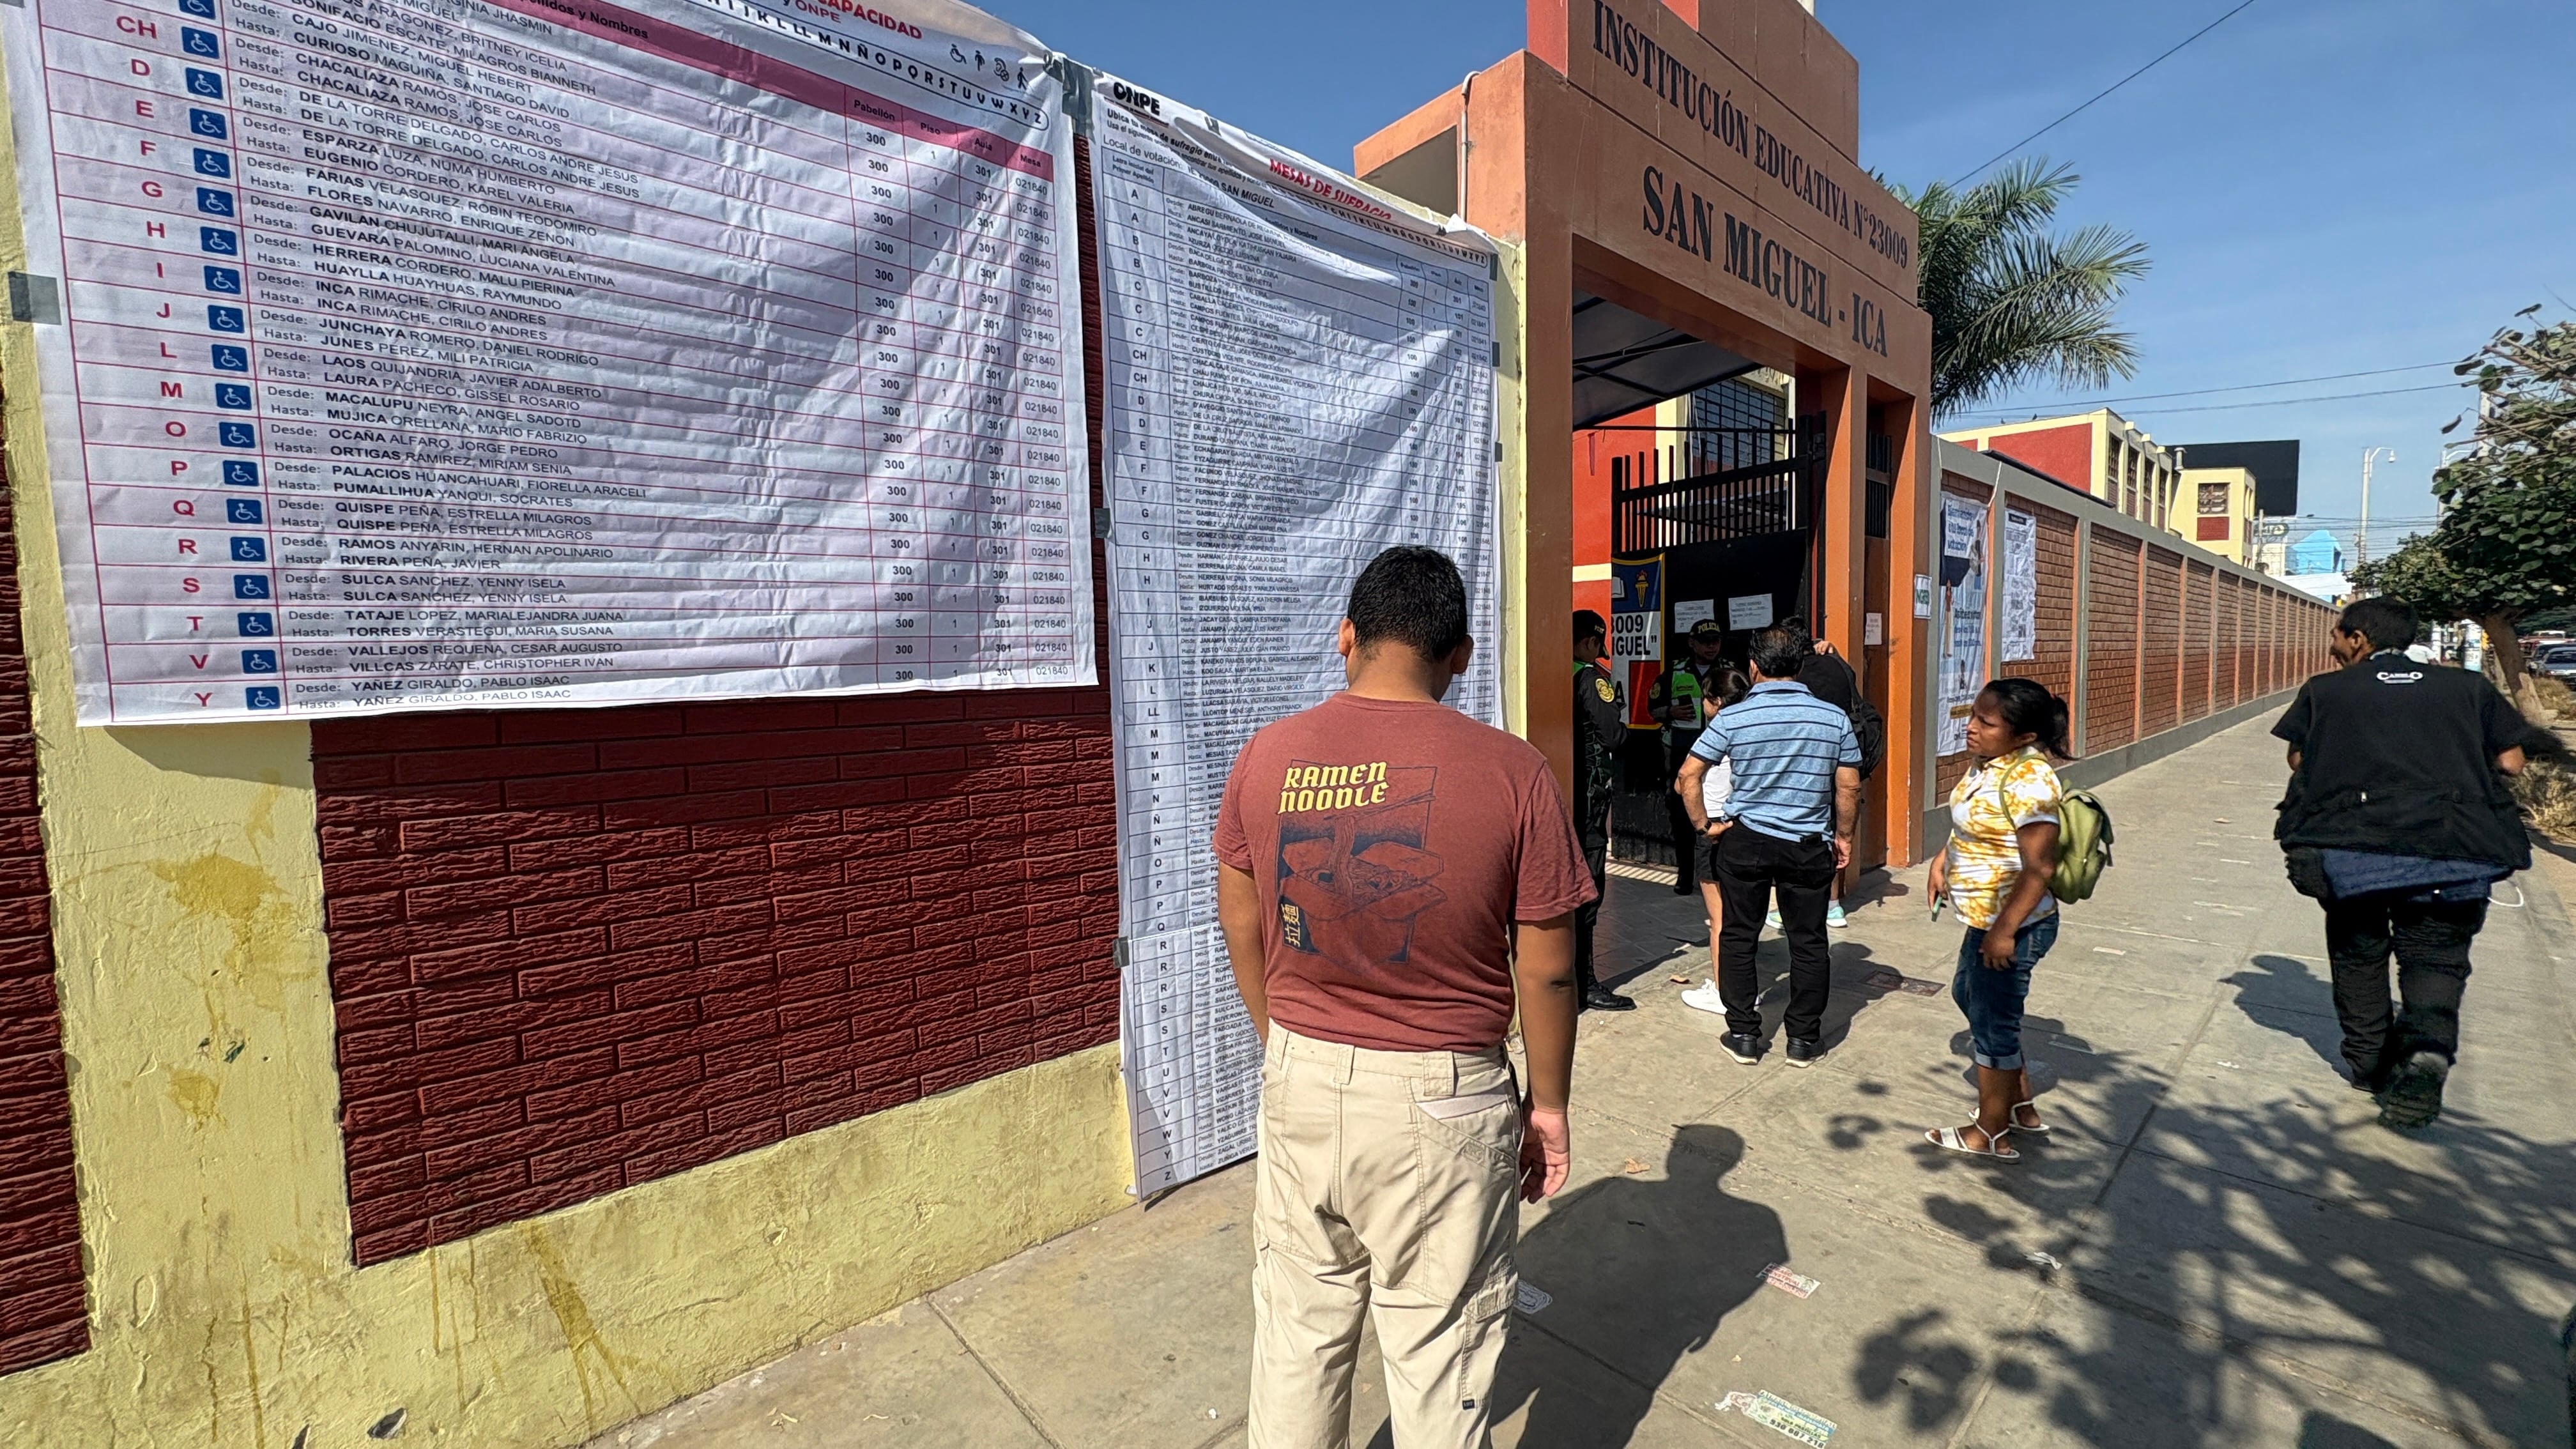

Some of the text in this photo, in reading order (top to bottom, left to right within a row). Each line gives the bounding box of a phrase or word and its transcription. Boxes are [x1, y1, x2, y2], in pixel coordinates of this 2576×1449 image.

[795, 0, 841, 24] ONPE
[116, 17, 157, 39] CH
[579, 10, 648, 39] y Nombres
[132, 59, 150, 75] D
[234, 15, 569, 118] Hasta: CURIOSO MAGUIÑA, SANTIAGO DAVID
[875, 53, 1041, 124] O P Q R S T U V W X Y Z
[238, 54, 562, 148] Hasta: CHACALIAZA RAMOS, JOSE CARLOS
[1114, 82, 1160, 116] ONPE
[136, 100, 154, 118] E
[1593, 0, 1749, 159] INSTITUCIÓN
[1754, 124, 1850, 231] EDUCATIVA
[238, 75, 638, 184] Desde: DE LA TORRE DELGADO, CARLOS ANDRE JESUS
[854, 100, 895, 121] Pabellón
[921, 122, 940, 135] Piso
[1020, 155, 1041, 167] Mesa
[1107, 109, 1130, 124] Ubica
[1131, 119, 1138, 128] tu
[1170, 137, 1202, 157] sufragio
[141, 141, 155, 155] F
[1103, 134, 1181, 169] Local de votación:
[866, 132, 1048, 195] 300 1 301 021840
[1269, 158, 1310, 188] MESAS
[1312, 180, 1332, 197] DE
[142, 181, 162, 197] G
[1131, 189, 1138, 199] A
[1221, 182, 1275, 208] SAN MIGUEL
[147, 221, 164, 238] H
[1133, 235, 1138, 245] B
[1643, 165, 1714, 263] SAN
[1724, 211, 1832, 328] MIGUEL
[1852, 293, 1888, 358] ICA
[157, 263, 163, 278] I
[257, 250, 561, 310] Hasta: HUAYLLA HUAYHUAS, RAYMUNDO
[257, 270, 546, 326] Desde: INCA RIMACHE, CIRILO ANDRES
[157, 303, 170, 318] J
[260, 308, 598, 367] Desde: JUNCHAYA ROMERO, DANIEL RODRIGO
[160, 342, 176, 358] L
[1133, 350, 1146, 360] CH
[160, 381, 182, 398] M
[165, 422, 186, 437] O
[270, 422, 557, 459] Desde: OCAÑA ALFARO, JORGE PEDRO
[171, 461, 187, 475] P
[274, 460, 320, 474] Desde:
[332, 464, 411, 480] PALACIOS
[528, 479, 591, 494] FIORELLA
[594, 485, 646, 498] ARACELI
[174, 500, 194, 516] Q
[1142, 509, 1149, 518] G
[179, 539, 197, 554] R
[284, 553, 500, 570] Hasta: RIVERA PEÑA, JAVIER
[183, 578, 199, 593] S
[285, 571, 565, 590] Desde: SULCA SANCHEZ, YENNY ISELA
[187, 616, 203, 631] T
[896, 619, 1066, 628] 300 1 301 021840
[189, 655, 208, 669] V
[1149, 664, 1155, 672] K
[295, 675, 569, 694] Desde: YAÑEZ GIRALDO, PABLO ISAAC
[194, 693, 212, 707] Y
[1149, 707, 1160, 716] LL
[1282, 762, 1388, 790] RAMEN
[1277, 782, 1390, 815] NOODLE
[1154, 814, 1160, 824] Ñ
[1160, 941, 1167, 950] R
[1163, 1130, 1172, 1138] W
[1165, 1172, 1171, 1181] Z
